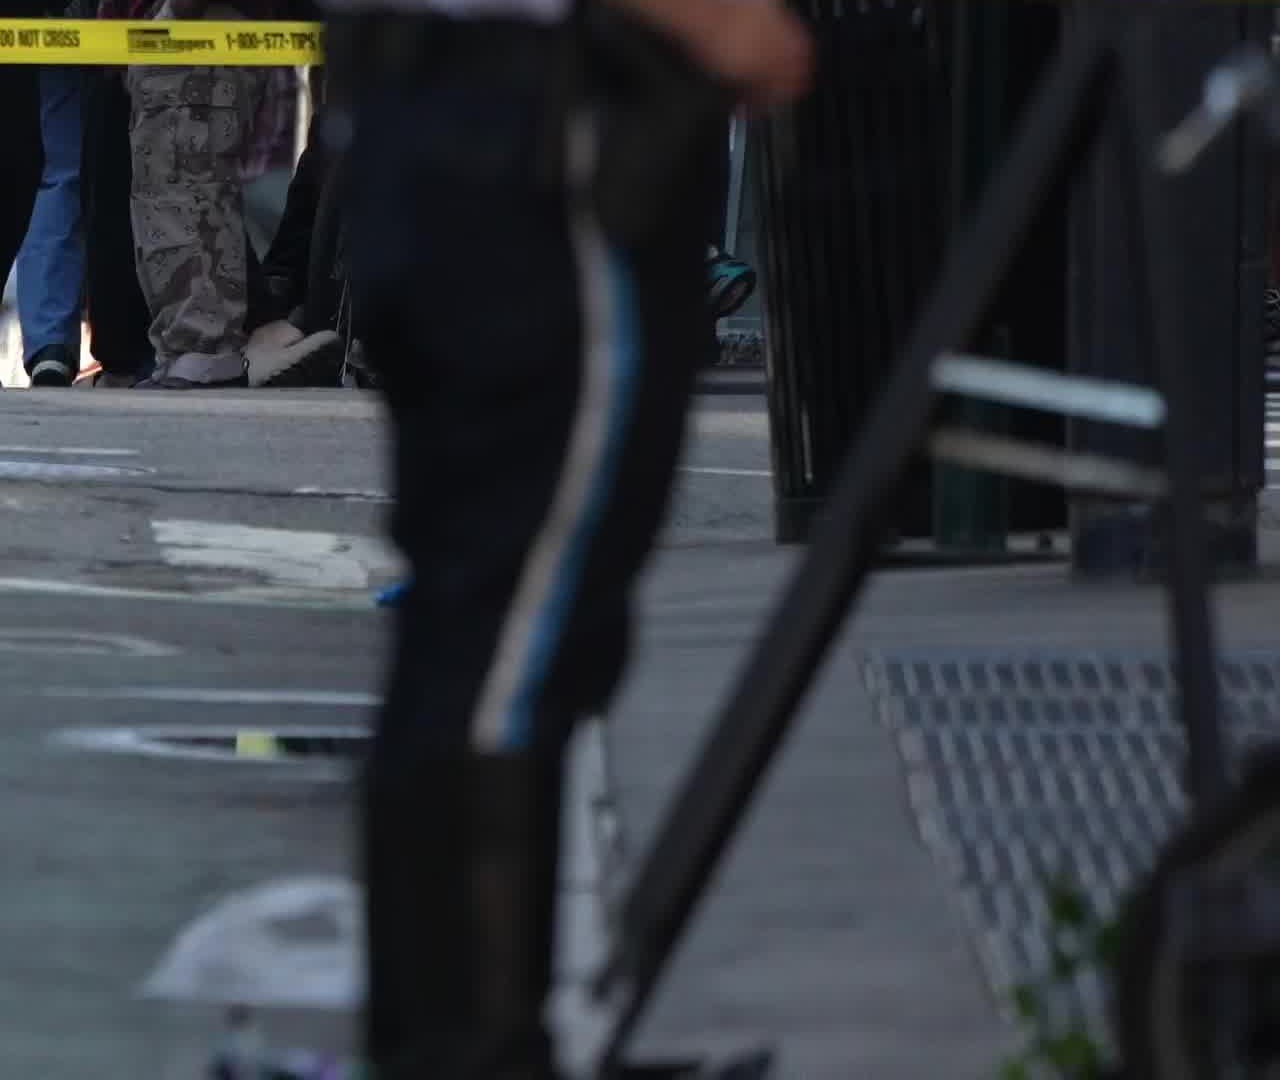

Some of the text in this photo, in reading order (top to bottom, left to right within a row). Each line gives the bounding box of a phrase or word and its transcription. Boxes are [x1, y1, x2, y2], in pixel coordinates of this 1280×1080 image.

[0, 29, 16, 47] DO
[18, 29, 40, 47] NOT
[43, 29, 81, 48] CROSS
